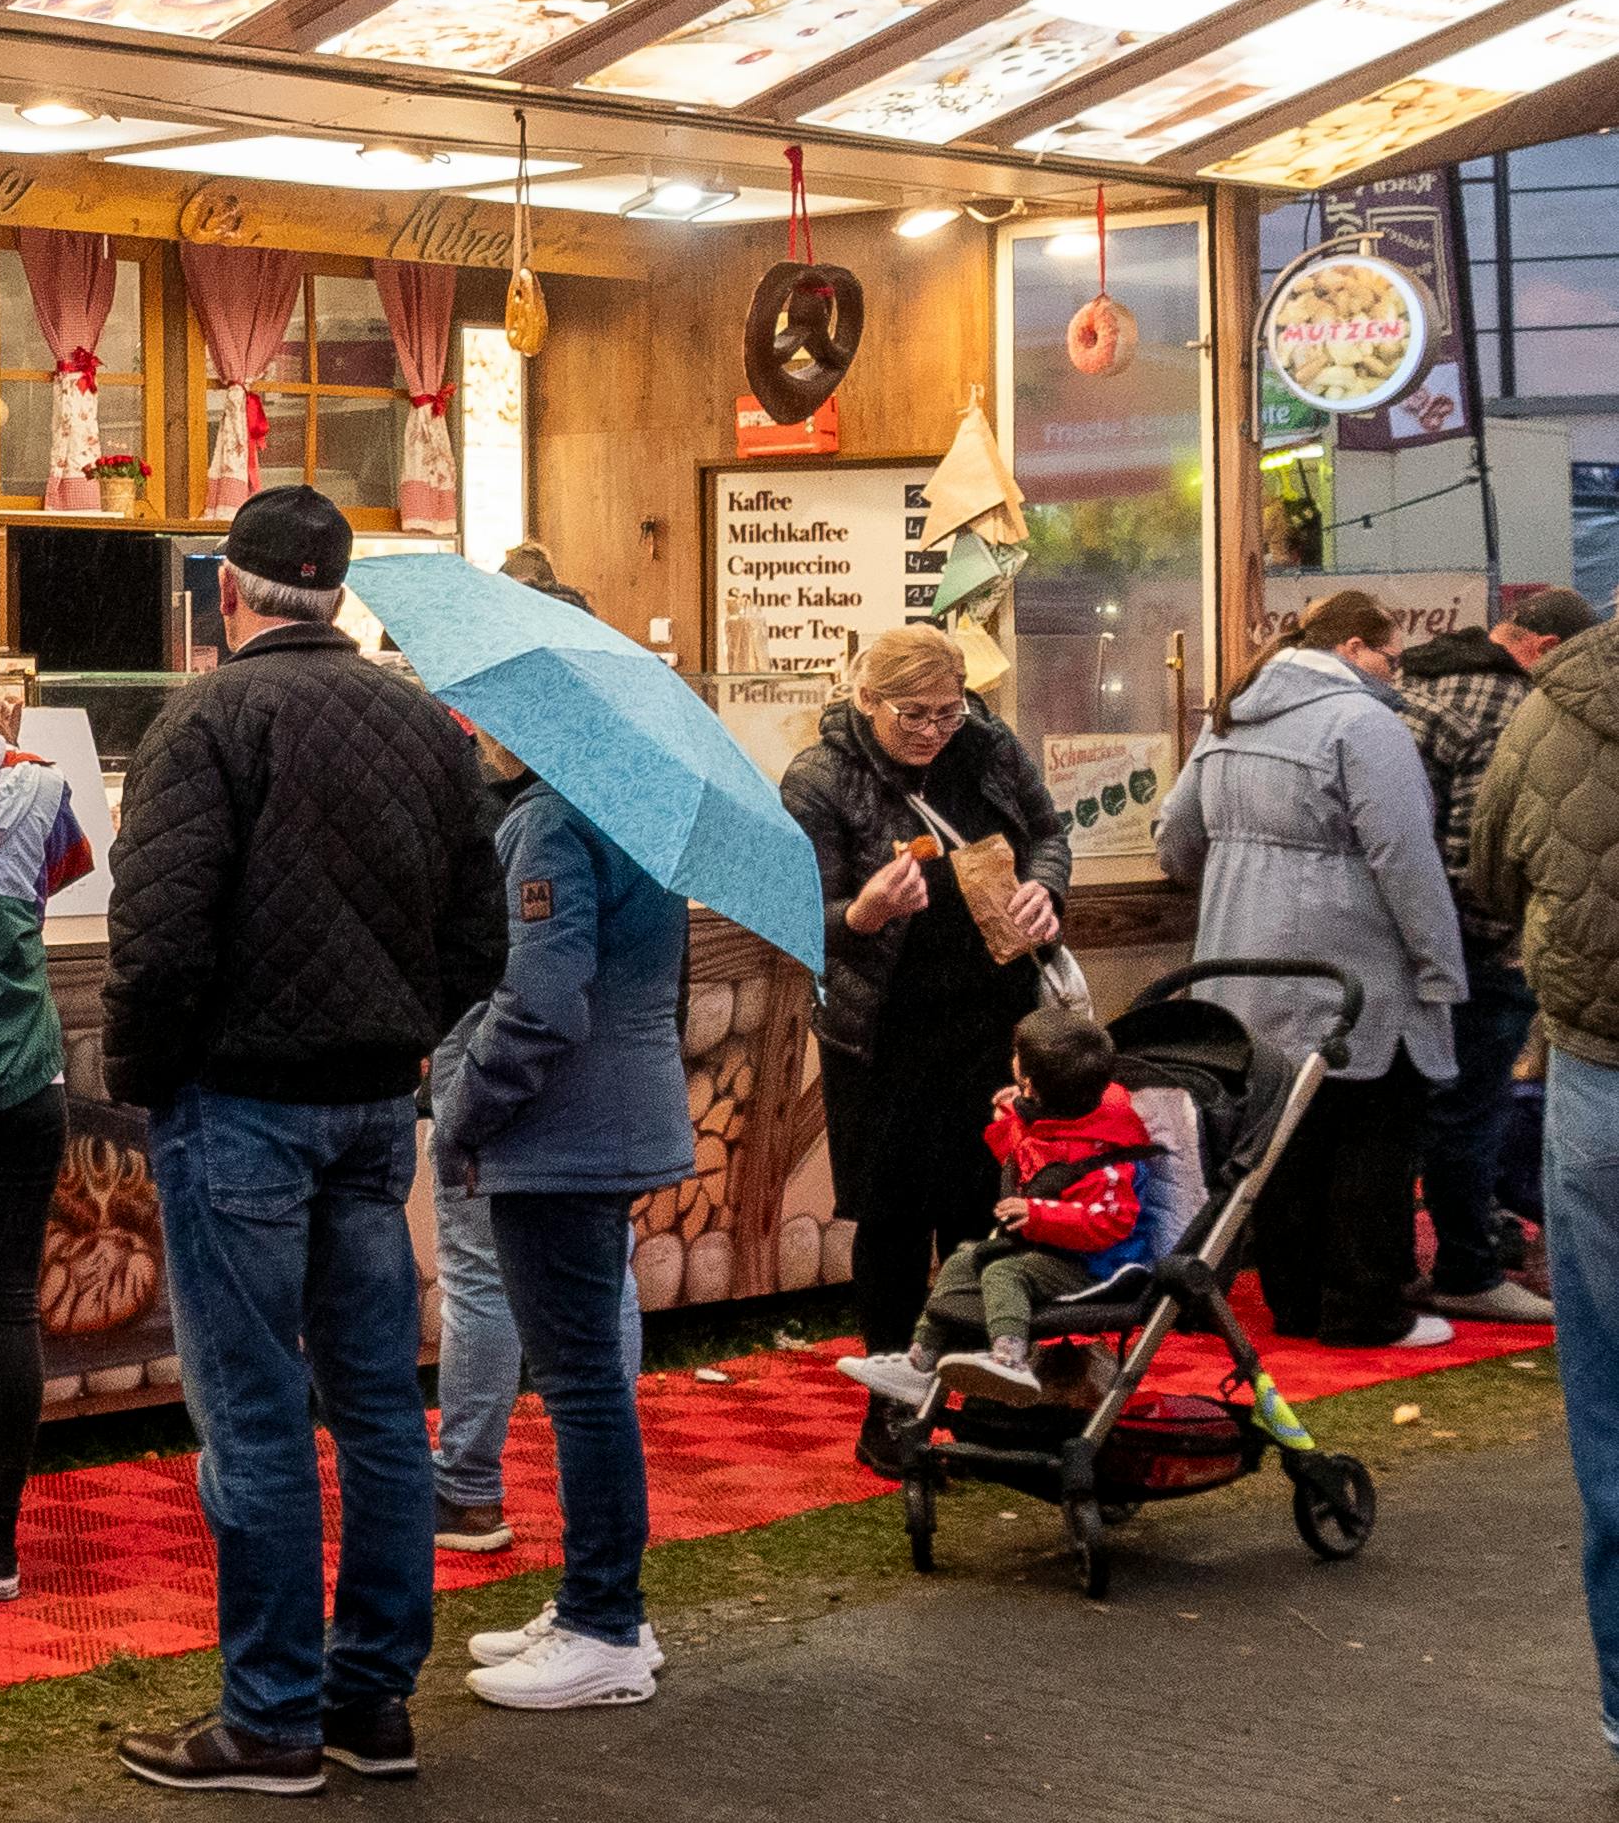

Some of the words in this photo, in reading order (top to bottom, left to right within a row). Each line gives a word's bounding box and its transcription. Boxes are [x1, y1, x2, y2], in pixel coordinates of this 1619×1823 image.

[1282, 320, 1404, 343] MUTZEN
[727, 490, 793, 512] Kaffee
[727, 521, 849, 544] Milchkaffee
[727, 554, 851, 580] Cappuccino
[727, 586, 791, 608] Sahne
[797, 586, 863, 608] Kakao
[768, 622, 803, 640] ner
[808, 618, 845, 640] Tee
[769, 653, 836, 672] warzer
[728, 683, 825, 706] Pfeffermi
